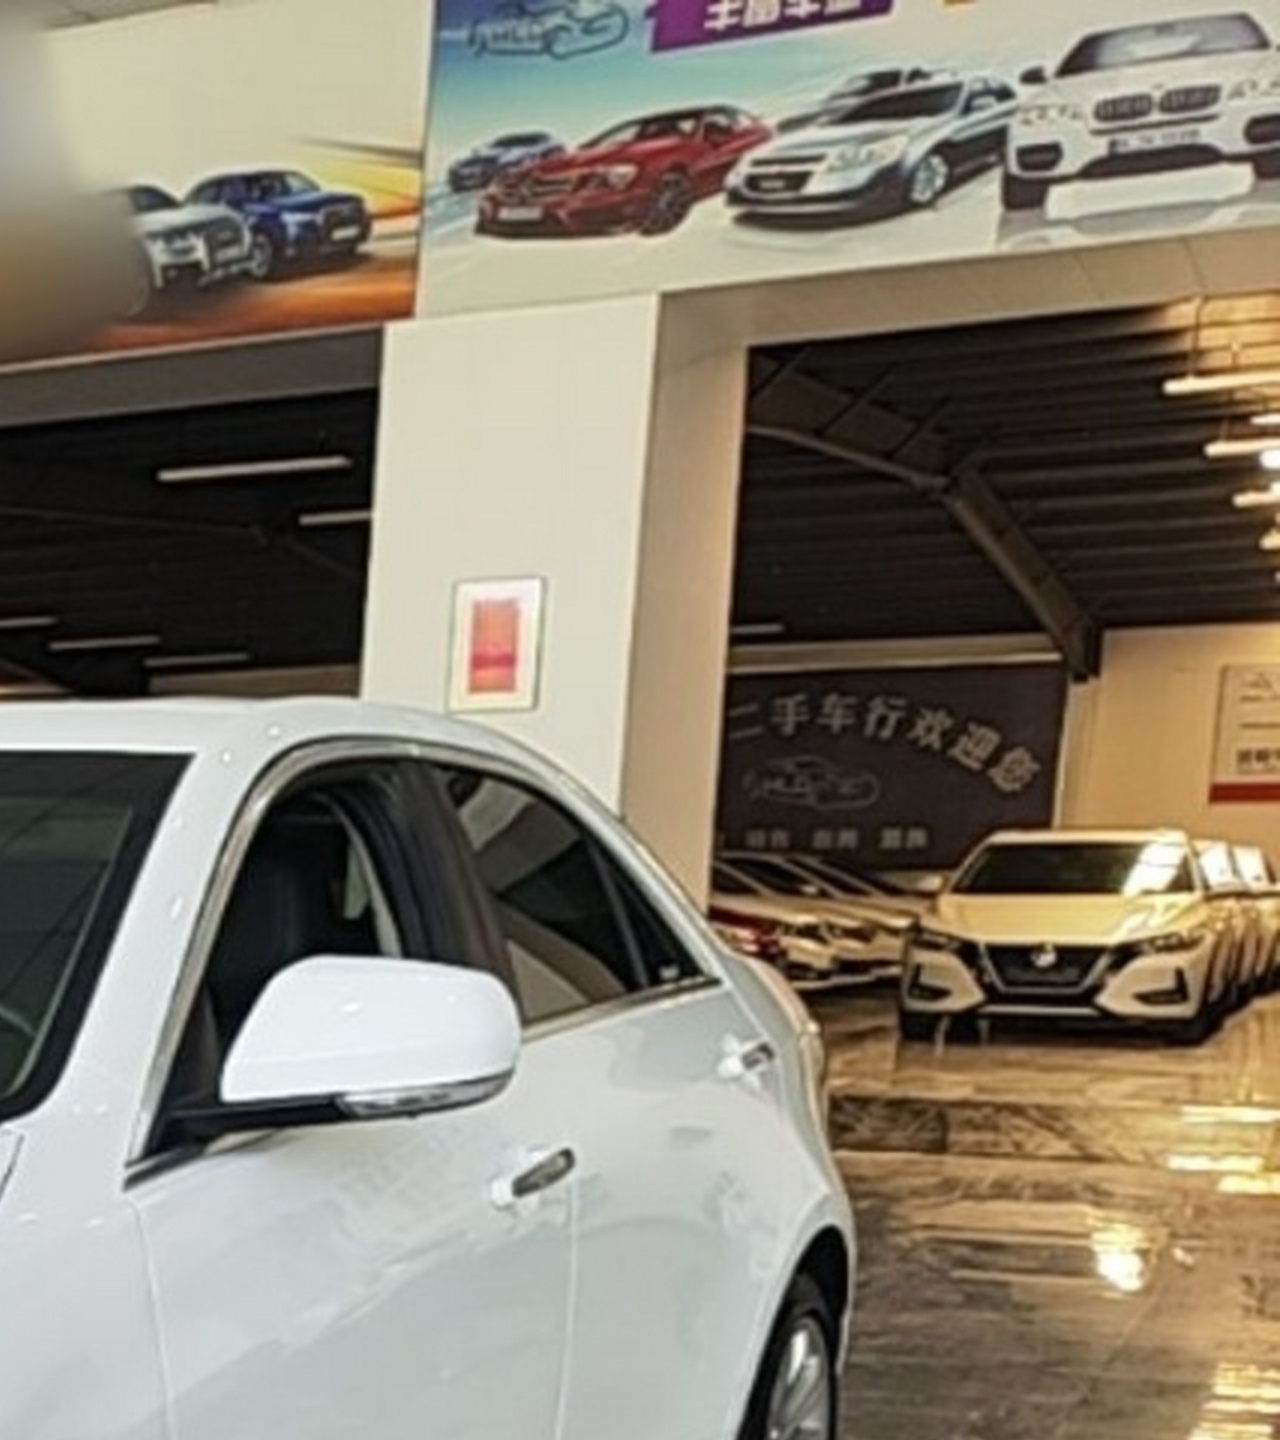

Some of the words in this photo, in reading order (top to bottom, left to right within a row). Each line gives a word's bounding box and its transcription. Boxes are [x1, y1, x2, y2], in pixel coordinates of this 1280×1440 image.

[728, 691, 1041, 793] 二手车行欢迎您
